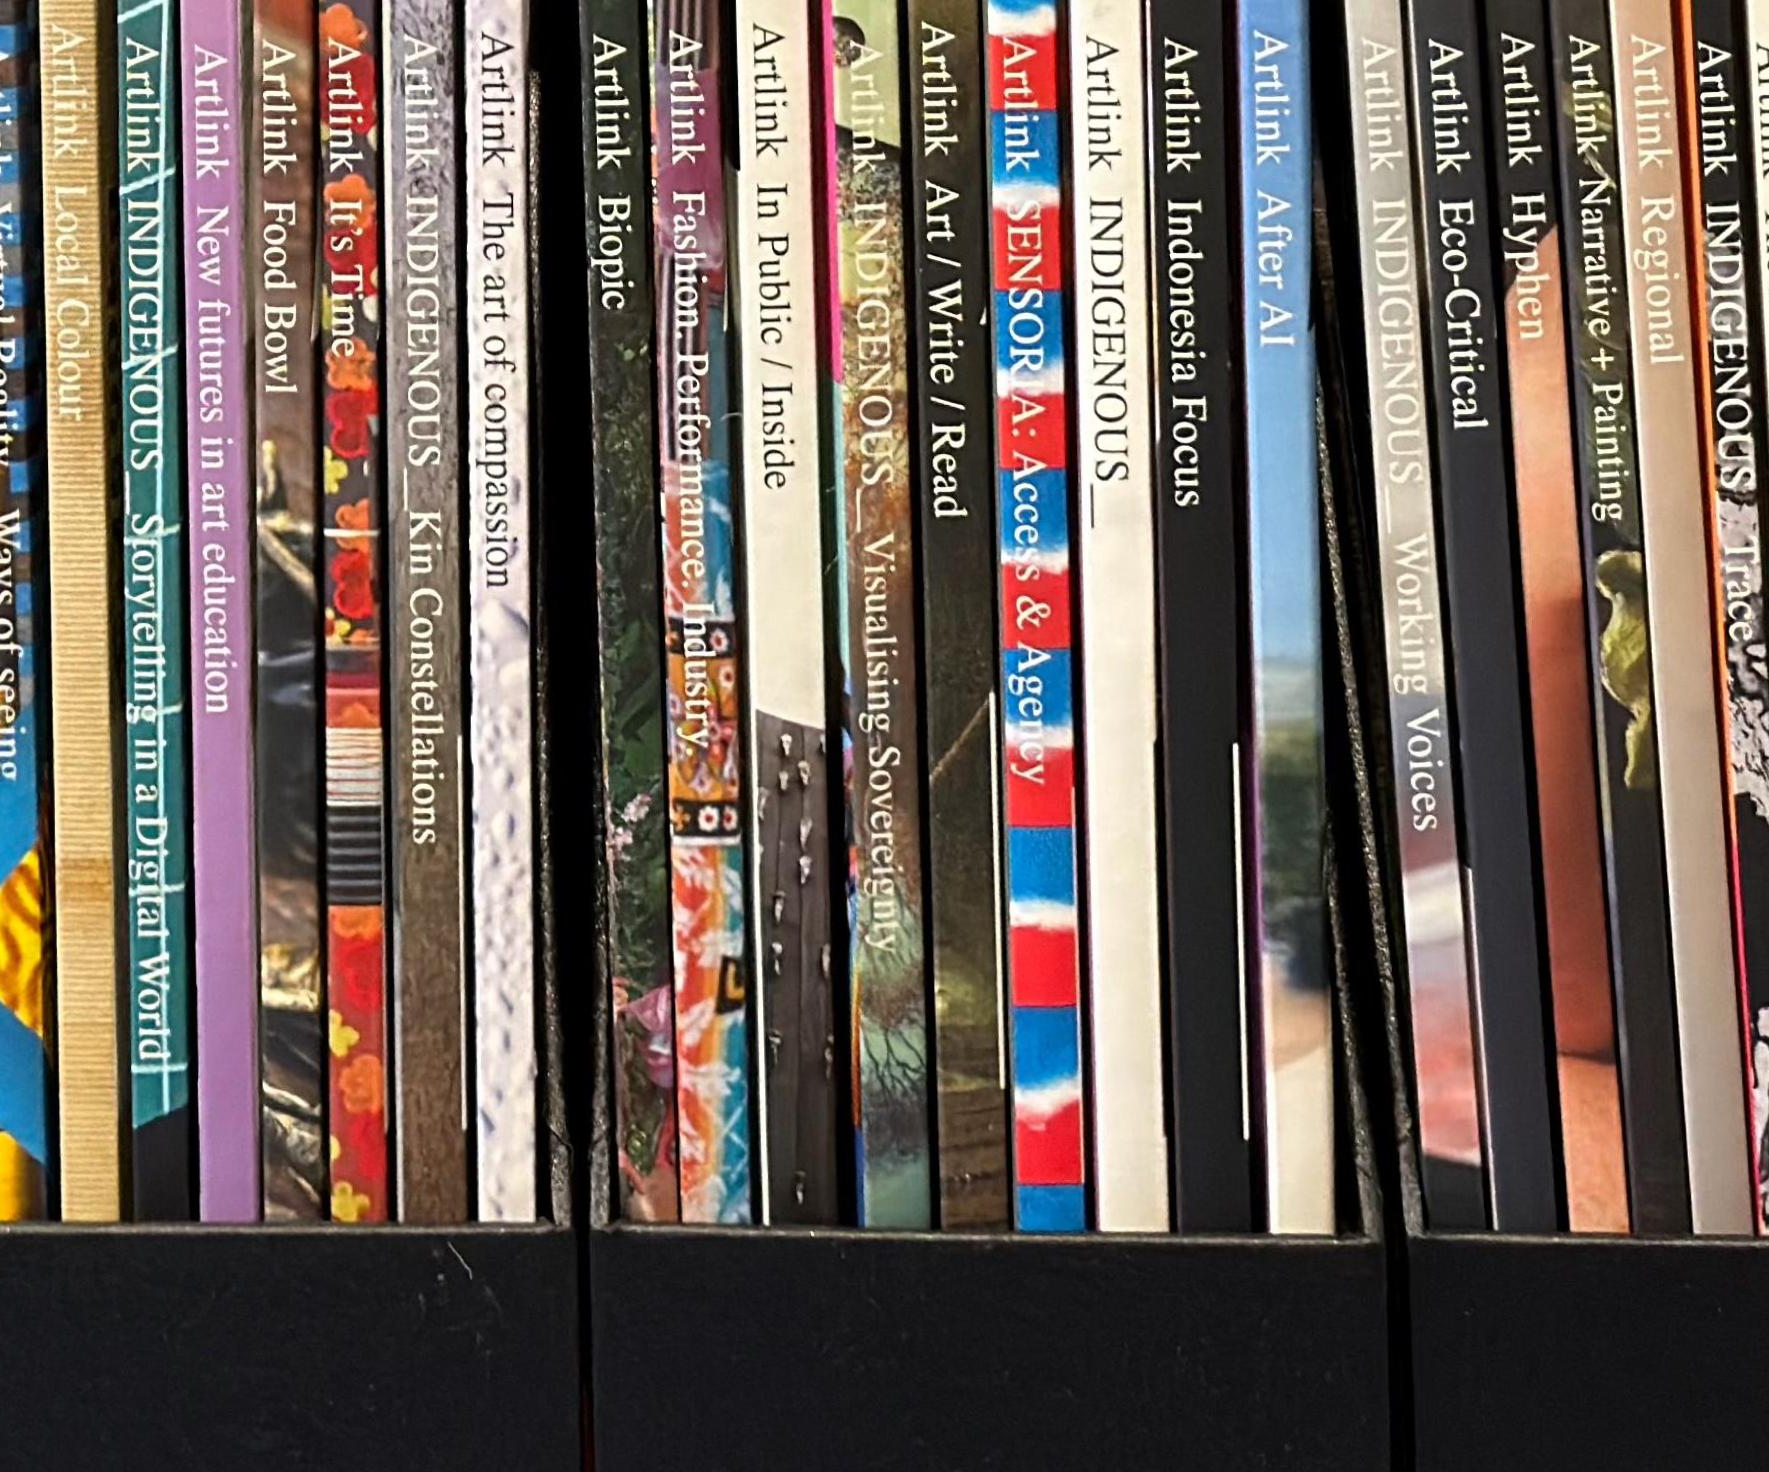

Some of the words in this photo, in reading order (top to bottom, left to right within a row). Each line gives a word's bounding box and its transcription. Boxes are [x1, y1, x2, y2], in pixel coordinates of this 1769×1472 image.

[49, 23, 87, 158] Artlink
[124, 37, 160, 174] Artlink
[193, 44, 231, 178] Artlink
[261, 39, 297, 174] Artlink
[327, 36, 363, 173] Artlink
[403, 34, 438, 169] Artlink
[480, 31, 516, 166] Artlink
[592, 34, 627, 169] Artlink
[669, 29, 706, 164] Artlink
[751, 23, 787, 157] Artlink
[849, 40, 885, 174] Artlink
[920, 21, 958, 156] Artlink
[1003, 37, 1041, 171] Artlink
[1085, 35, 1120, 171] Artlink
[1163, 37, 1200, 172] Artlink
[1253, 30, 1292, 165] Artlink
[1427, 38, 1469, 174] Artlink
[1499, 32, 1540, 166] Artlink
[1568, 35, 1608, 153] Artlink
[1630, 34, 1670, 169] Artlink
[1696, 40, 1736, 176] Artlink
[54, 185, 92, 284] Local
[197, 205, 229, 285] New
[263, 201, 296, 289] Food
[330, 199, 363, 251] It's
[482, 194, 515, 262] The
[591, 194, 633, 311] Biopic
[671, 191, 707, 339] Fashion.
[757, 183, 788, 219] In
[925, 180, 961, 241] Art
[1256, 190, 1295, 289] After
[1502, 193, 1547, 340] Hyphen
[1578, 178, 1616, 335] Narrative
[331, 268, 365, 358] Time
[483, 274, 512, 322] art
[757, 233, 793, 344] Public
[928, 279, 964, 384] Write
[1166, 199, 1206, 382] Indonesia
[1258, 301, 1295, 345] AI
[1438, 199, 1488, 429] Eco-Critical
[1633, 196, 1683, 365] Regional
[57, 298, 92, 421] Colour
[199, 298, 236, 422] futures
[265, 304, 297, 394] Bowl
[476, 382, 519, 586] compassion
[676, 352, 710, 587] Performance.
[761, 382, 796, 490] Inside
[932, 422, 967, 518] Read
[1172, 396, 1207, 507] Focus
[1360, 36, 1399, 171] Artlink
[1405, 709, 1443, 831] Voices
[1590, 383, 1629, 522] Painting
[202, 482, 236, 530] art
[1010, 451, 1049, 581] Access
[202, 542, 241, 712] education
[676, 602, 716, 757] Industry.
[409, 587, 444, 844] Constellations
[1009, 642, 1052, 785] Agency
[128, 816, 171, 937] Digital
[863, 745, 902, 954] Sovereignty
[137, 950, 171, 1061] World
